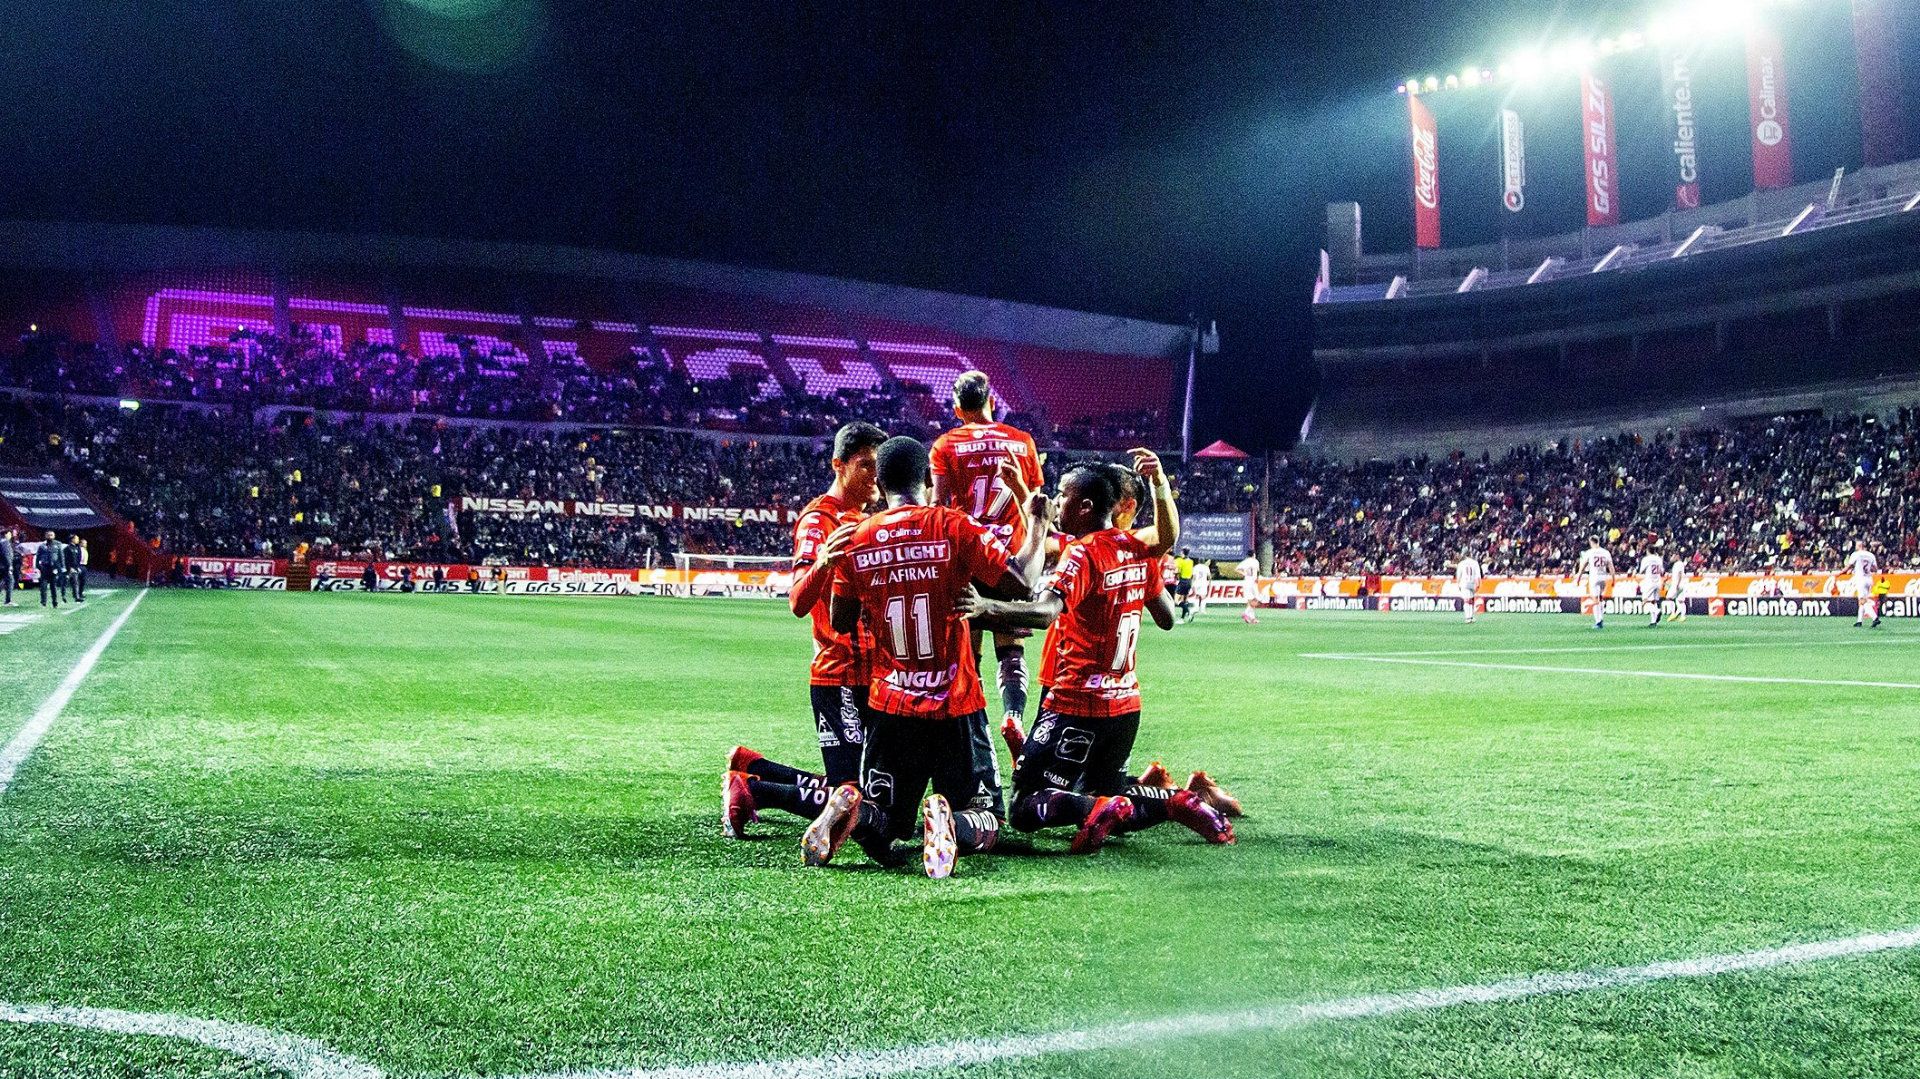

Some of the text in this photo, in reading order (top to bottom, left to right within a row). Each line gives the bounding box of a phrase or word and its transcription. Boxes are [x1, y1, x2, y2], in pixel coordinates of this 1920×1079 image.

[1760, 55, 1777, 119] Calimax
[957, 442, 987, 453] BUD
[973, 476, 1013, 519] 17
[462, 497, 565, 514] NISSAN
[575, 501, 673, 518] NISSAN
[683, 507, 778, 523] NISSAN
[889, 528, 923, 539] Calimax
[856, 544, 947, 569] BUD LIGHT
[888, 566, 940, 584] AFIRME
[526, 582, 618, 593] GAS SILZA
[1486, 597, 1562, 613] caliente.mx
[1727, 597, 1831, 616] caliente.mx
[885, 593, 934, 660] 11
[1043, 770, 1070, 787] CHARLY
